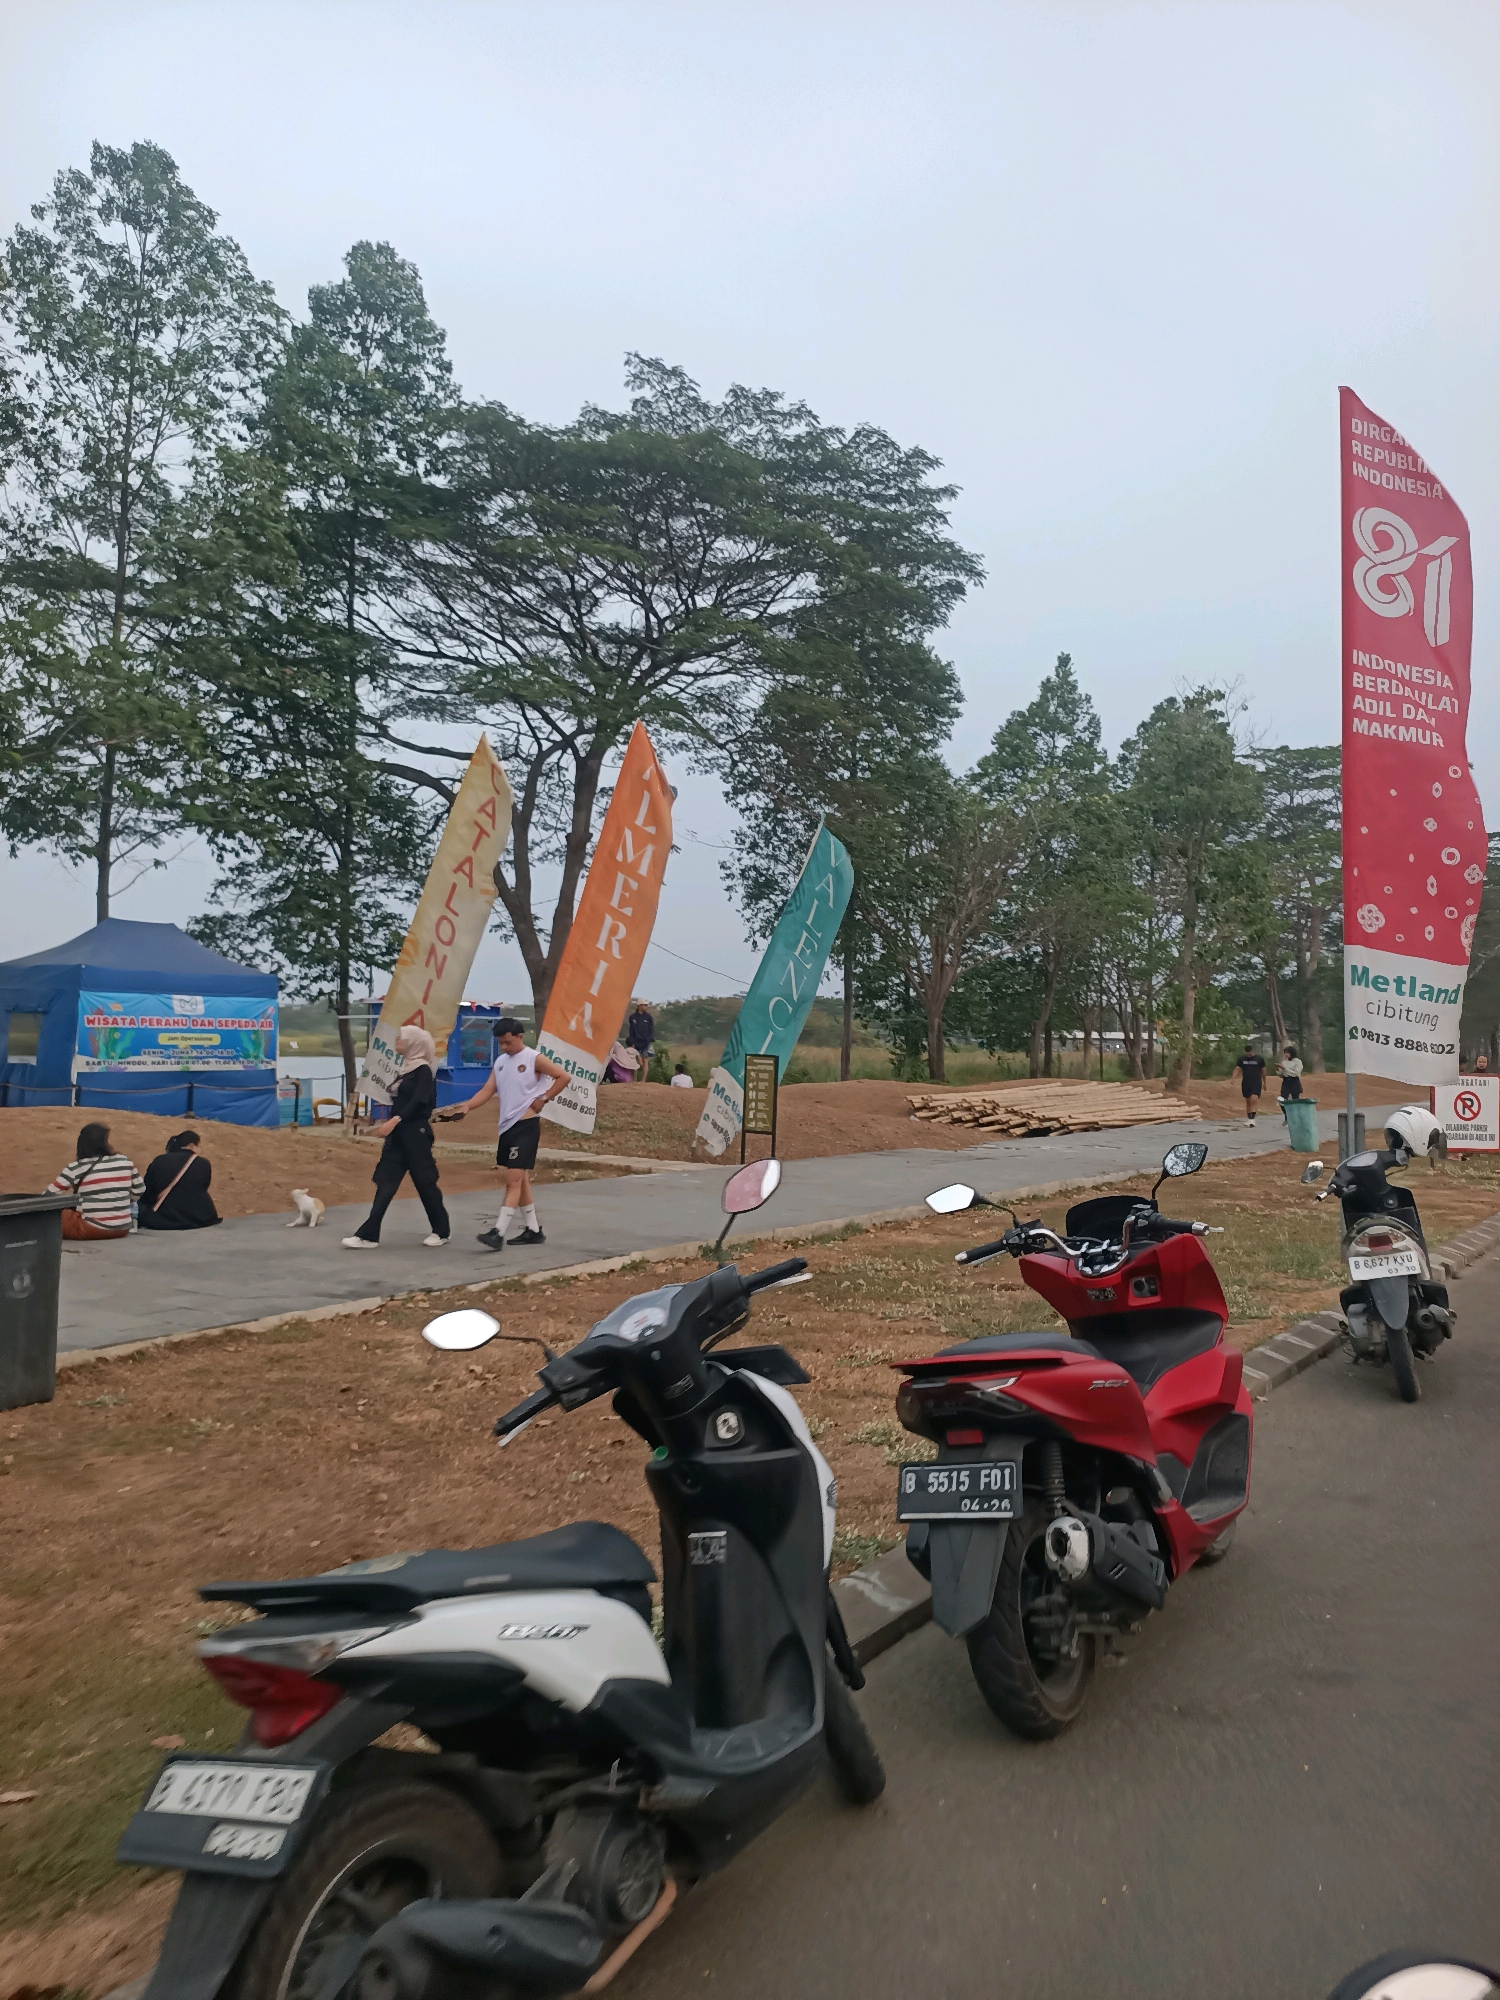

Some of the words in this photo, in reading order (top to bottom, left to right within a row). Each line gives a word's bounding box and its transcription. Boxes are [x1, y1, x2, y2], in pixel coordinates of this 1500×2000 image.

[1352, 461, 1443, 499] INDONESIA
[1352, 506, 1459, 647] 81
[1352, 648, 1454, 690] INDONESIA
[1352, 671, 1459, 714] BERDAULAT
[1352, 694, 1397, 718] ADIL
[1402, 702, 1436, 728] DAN
[1352, 717, 1445, 747] MAKMUR
[1350, 964, 1462, 1005] Metland
[85, 1016, 137, 1027] WISATA
[140, 1017, 187, 1027] PERAHU
[192, 1019, 214, 1028] DAN
[217, 1019, 256, 1029] SEPEDA
[260, 1020, 273, 1029] AIR
[1366, 999, 1439, 1032] cibitung
[1360, 1027, 1391, 1046] 0813
[1393, 1037, 1429, 1053] 8888
[905, 1472, 917, 1493] B
[927, 1470, 970, 1493] 5515
